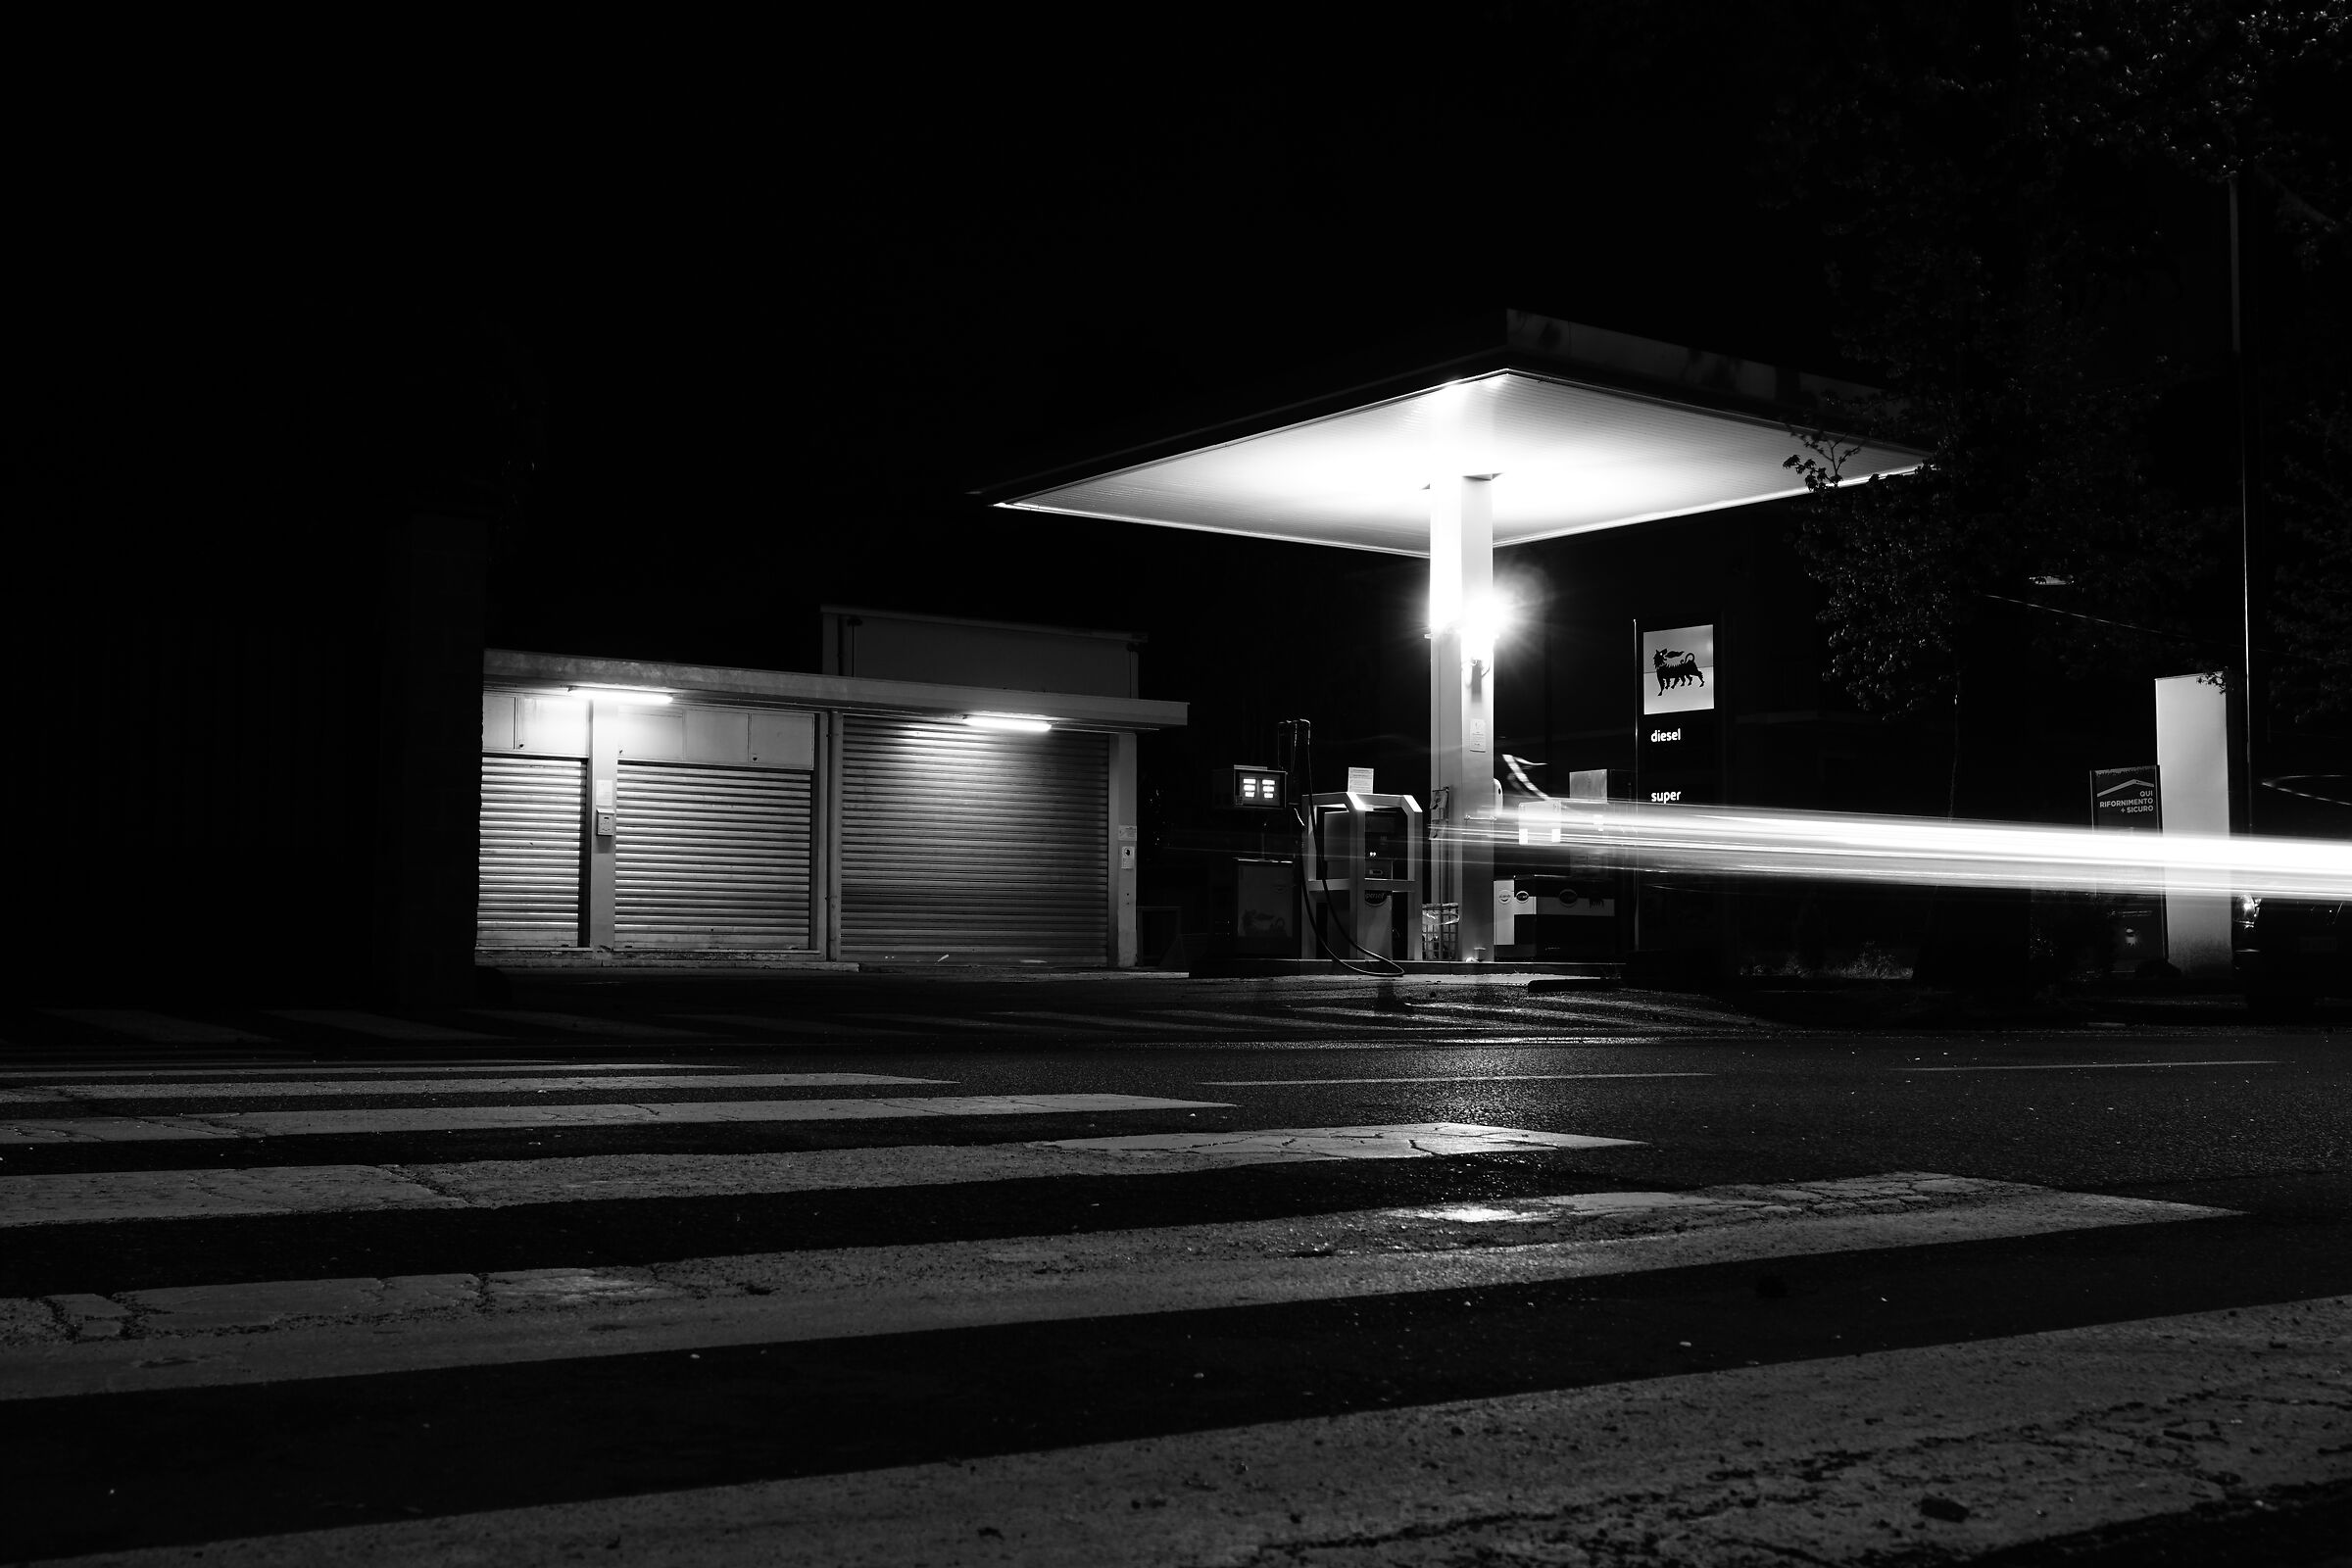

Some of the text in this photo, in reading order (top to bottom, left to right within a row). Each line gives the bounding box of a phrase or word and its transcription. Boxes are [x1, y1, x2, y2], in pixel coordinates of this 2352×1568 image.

[1650, 728, 1681, 743] diesel
[1650, 791, 1682, 805] super
[2099, 797, 2154, 808] RIFORNIMENTO
[2126, 805, 2154, 813] SICURO
